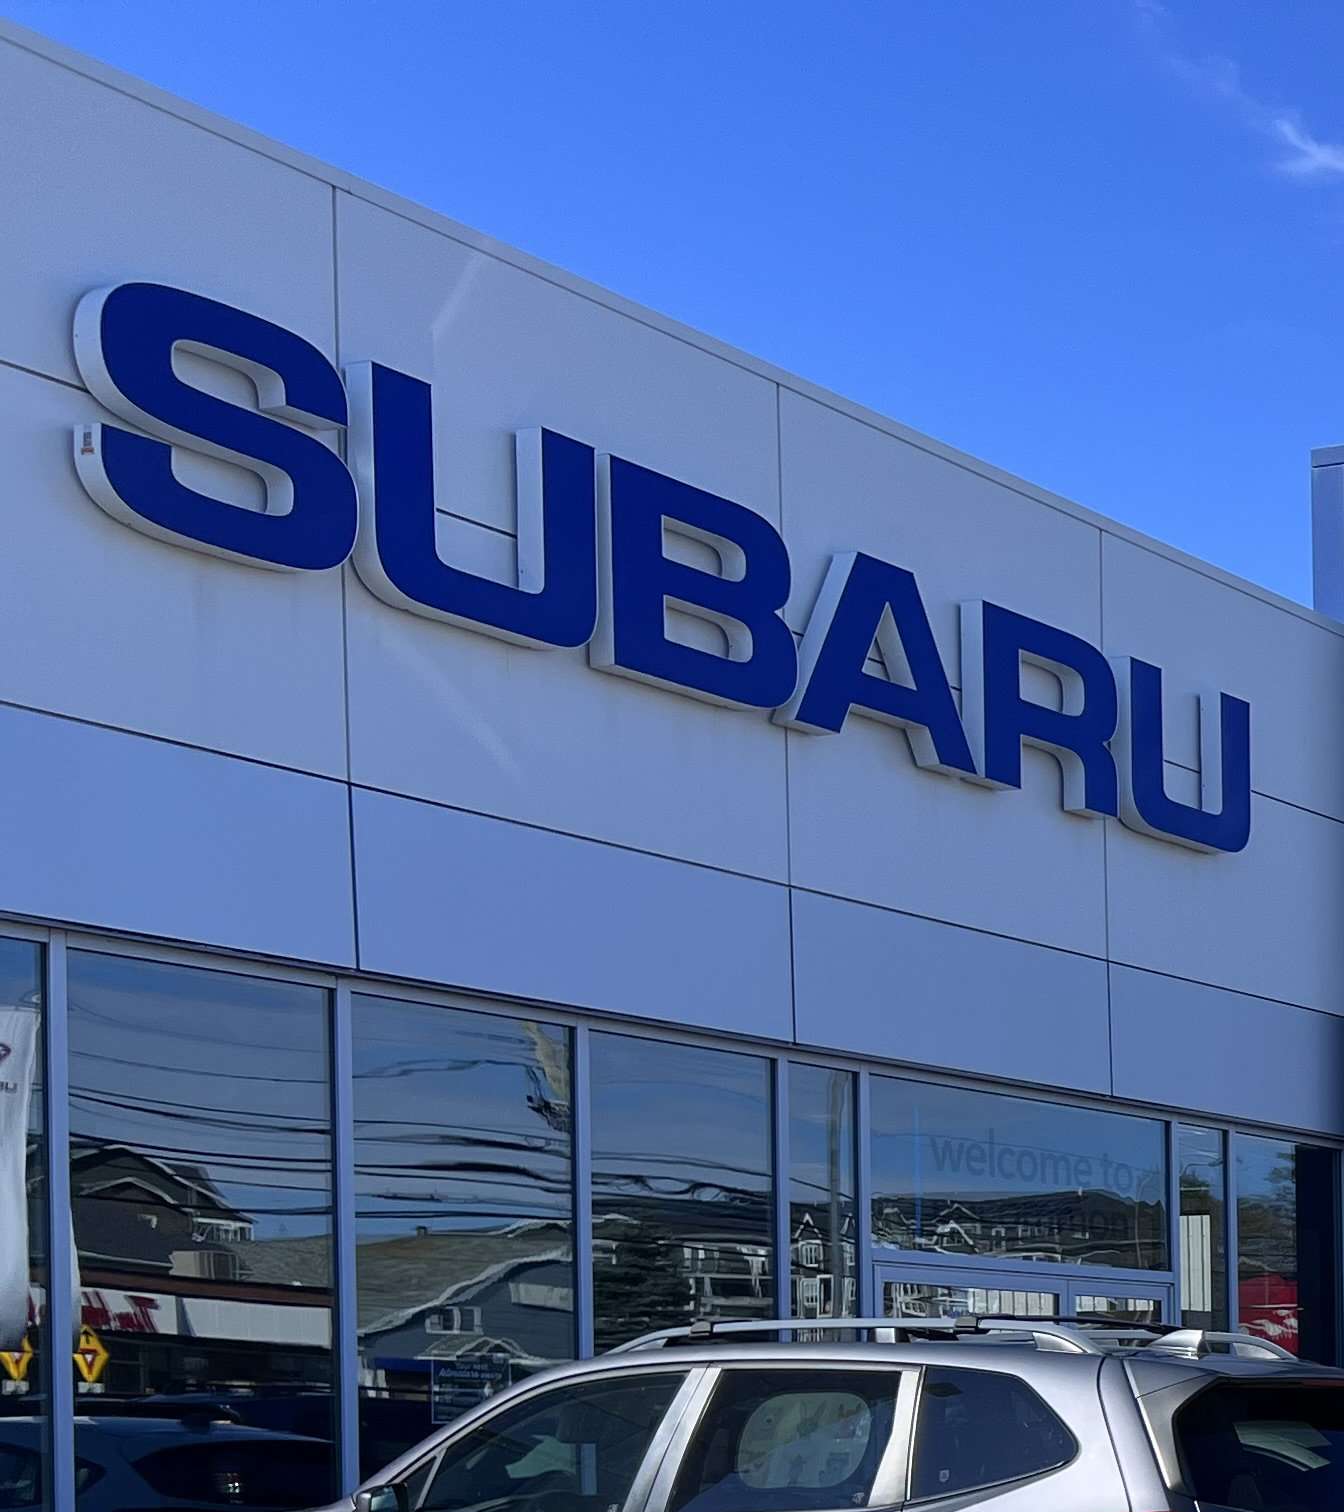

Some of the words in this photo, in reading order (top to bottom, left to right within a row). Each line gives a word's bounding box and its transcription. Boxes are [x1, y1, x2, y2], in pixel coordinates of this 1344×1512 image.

[74, 282, 1251, 855] SUBARU
[929, 1128, 1094, 1188] welcome
[1102, 1153, 1133, 1192] to
